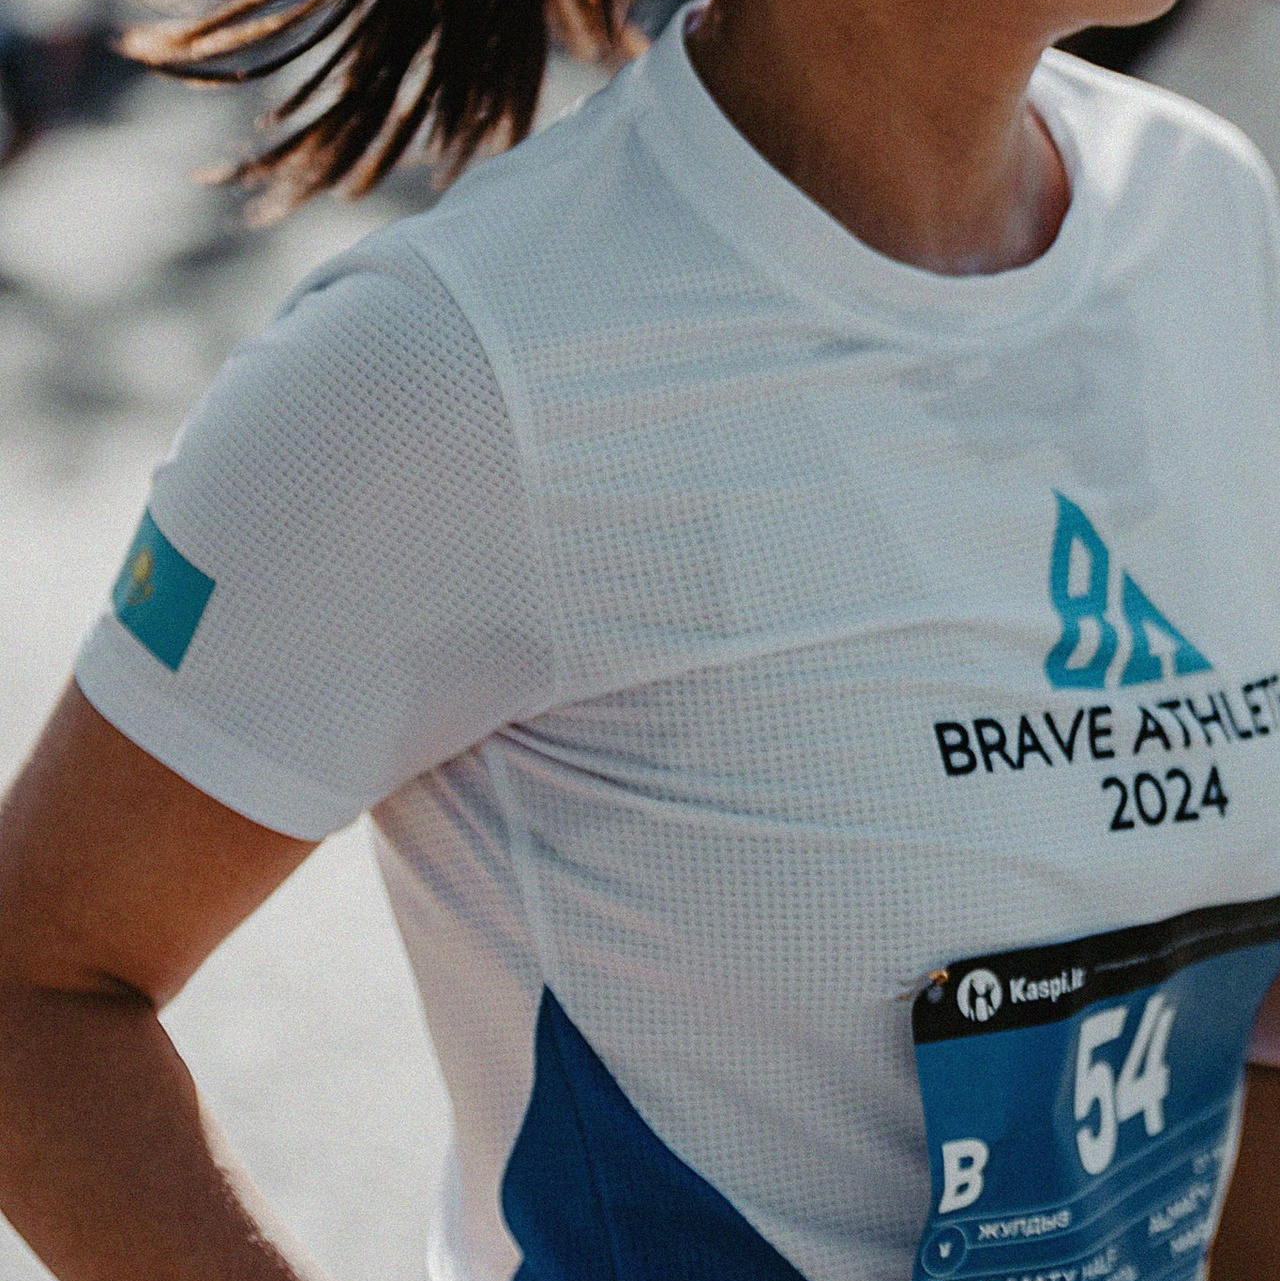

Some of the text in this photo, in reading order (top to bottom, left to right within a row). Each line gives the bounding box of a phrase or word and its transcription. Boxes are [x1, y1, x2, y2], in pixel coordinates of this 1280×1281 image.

[934, 705, 1115, 776] BRAVE
[1101, 762, 1229, 832] 2024
[1073, 993, 1177, 1175] 54
[939, 1137, 990, 1214] B
